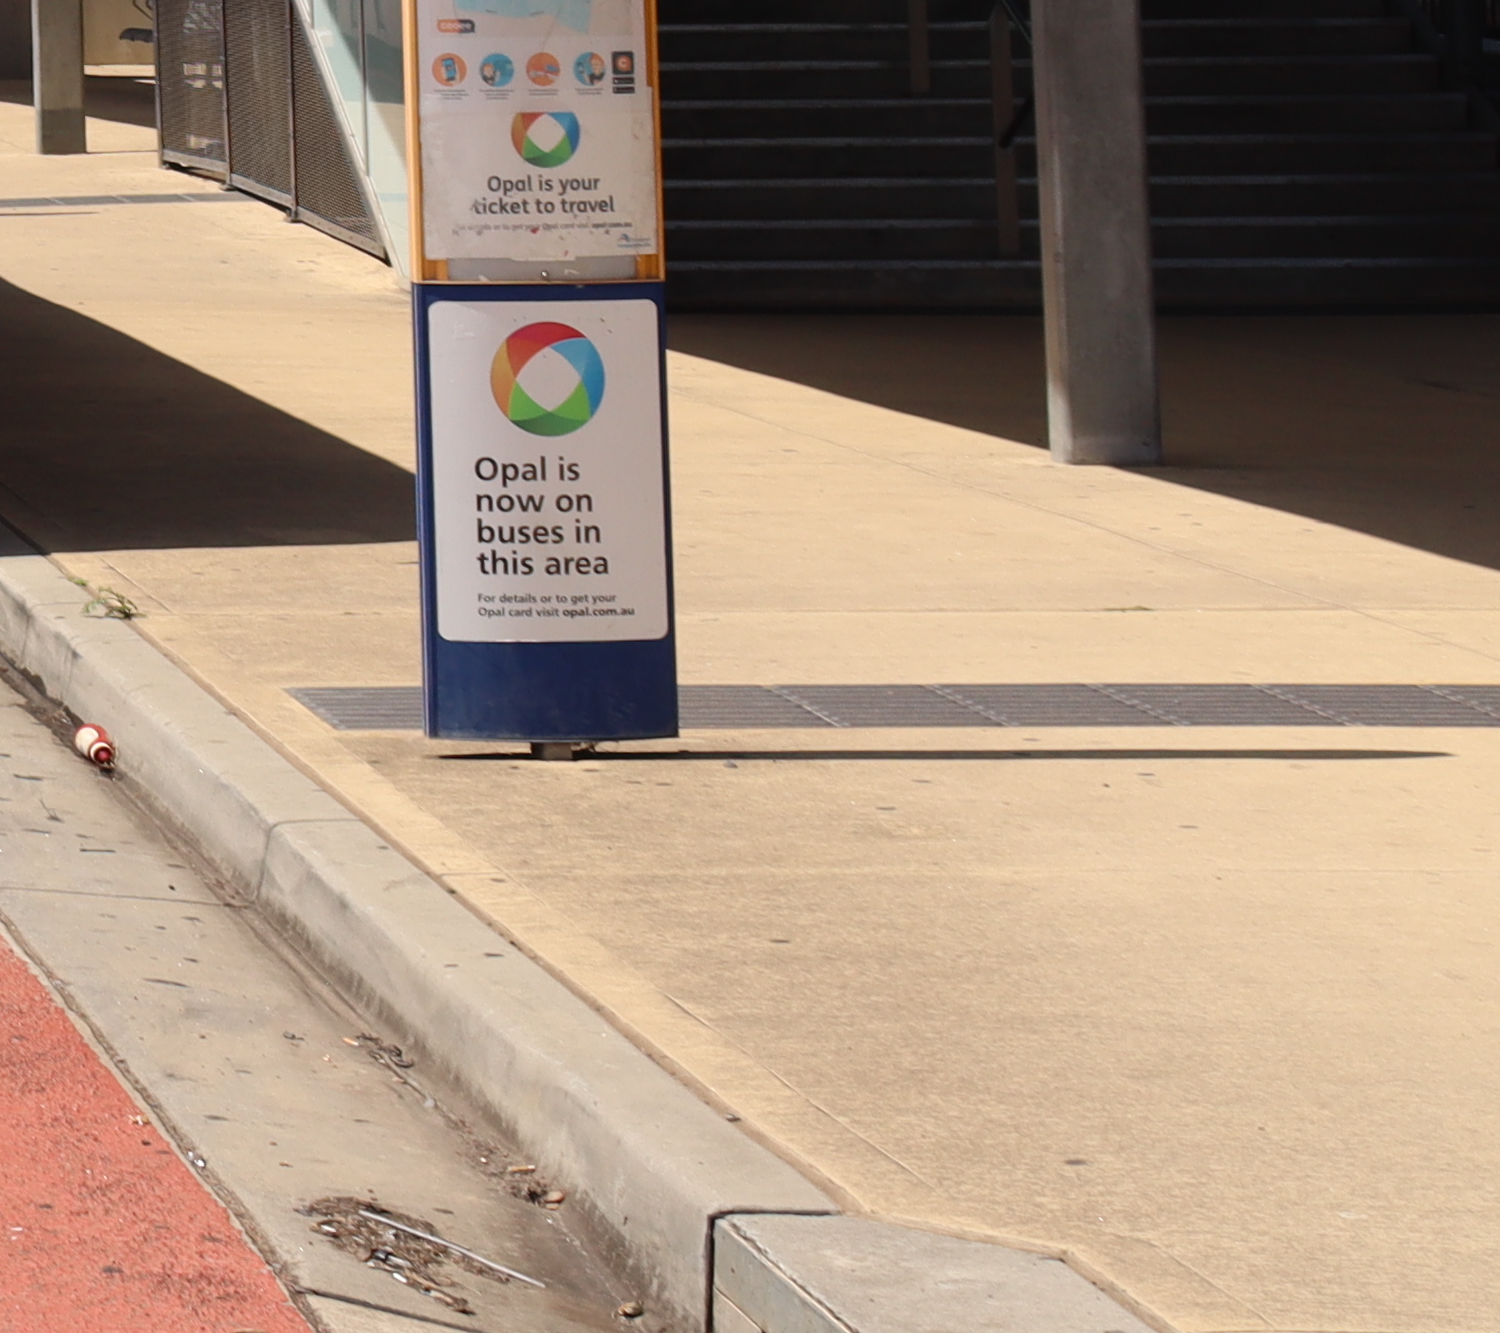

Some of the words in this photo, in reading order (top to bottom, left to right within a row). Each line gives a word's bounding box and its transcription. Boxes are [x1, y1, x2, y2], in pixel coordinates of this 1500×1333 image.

[487, 174, 533, 196] Opal
[538, 174, 554, 192] is
[558, 176, 601, 196] your
[473, 196, 530, 215] ticket
[535, 198, 555, 214] to
[562, 195, 615, 213] travel
[474, 455, 546, 488] Opal
[558, 455, 580, 481] is
[475, 493, 545, 512] now
[555, 493, 593, 512] on
[476, 517, 564, 544] buses
[574, 518, 601, 543] in
[476, 549, 534, 575] this
[544, 555, 609, 575] area
[477, 593, 495, 603] For
[499, 593, 537, 603] details
[539, 595, 552, 603] or
[555, 593, 568, 603] to
[570, 594, 589, 606] get
[591, 594, 617, 606] your
[477, 607, 505, 619] Opal
[508, 607, 532, 617] card
[536, 607, 560, 617] visit
[562, 607, 635, 619] opal.com.au
